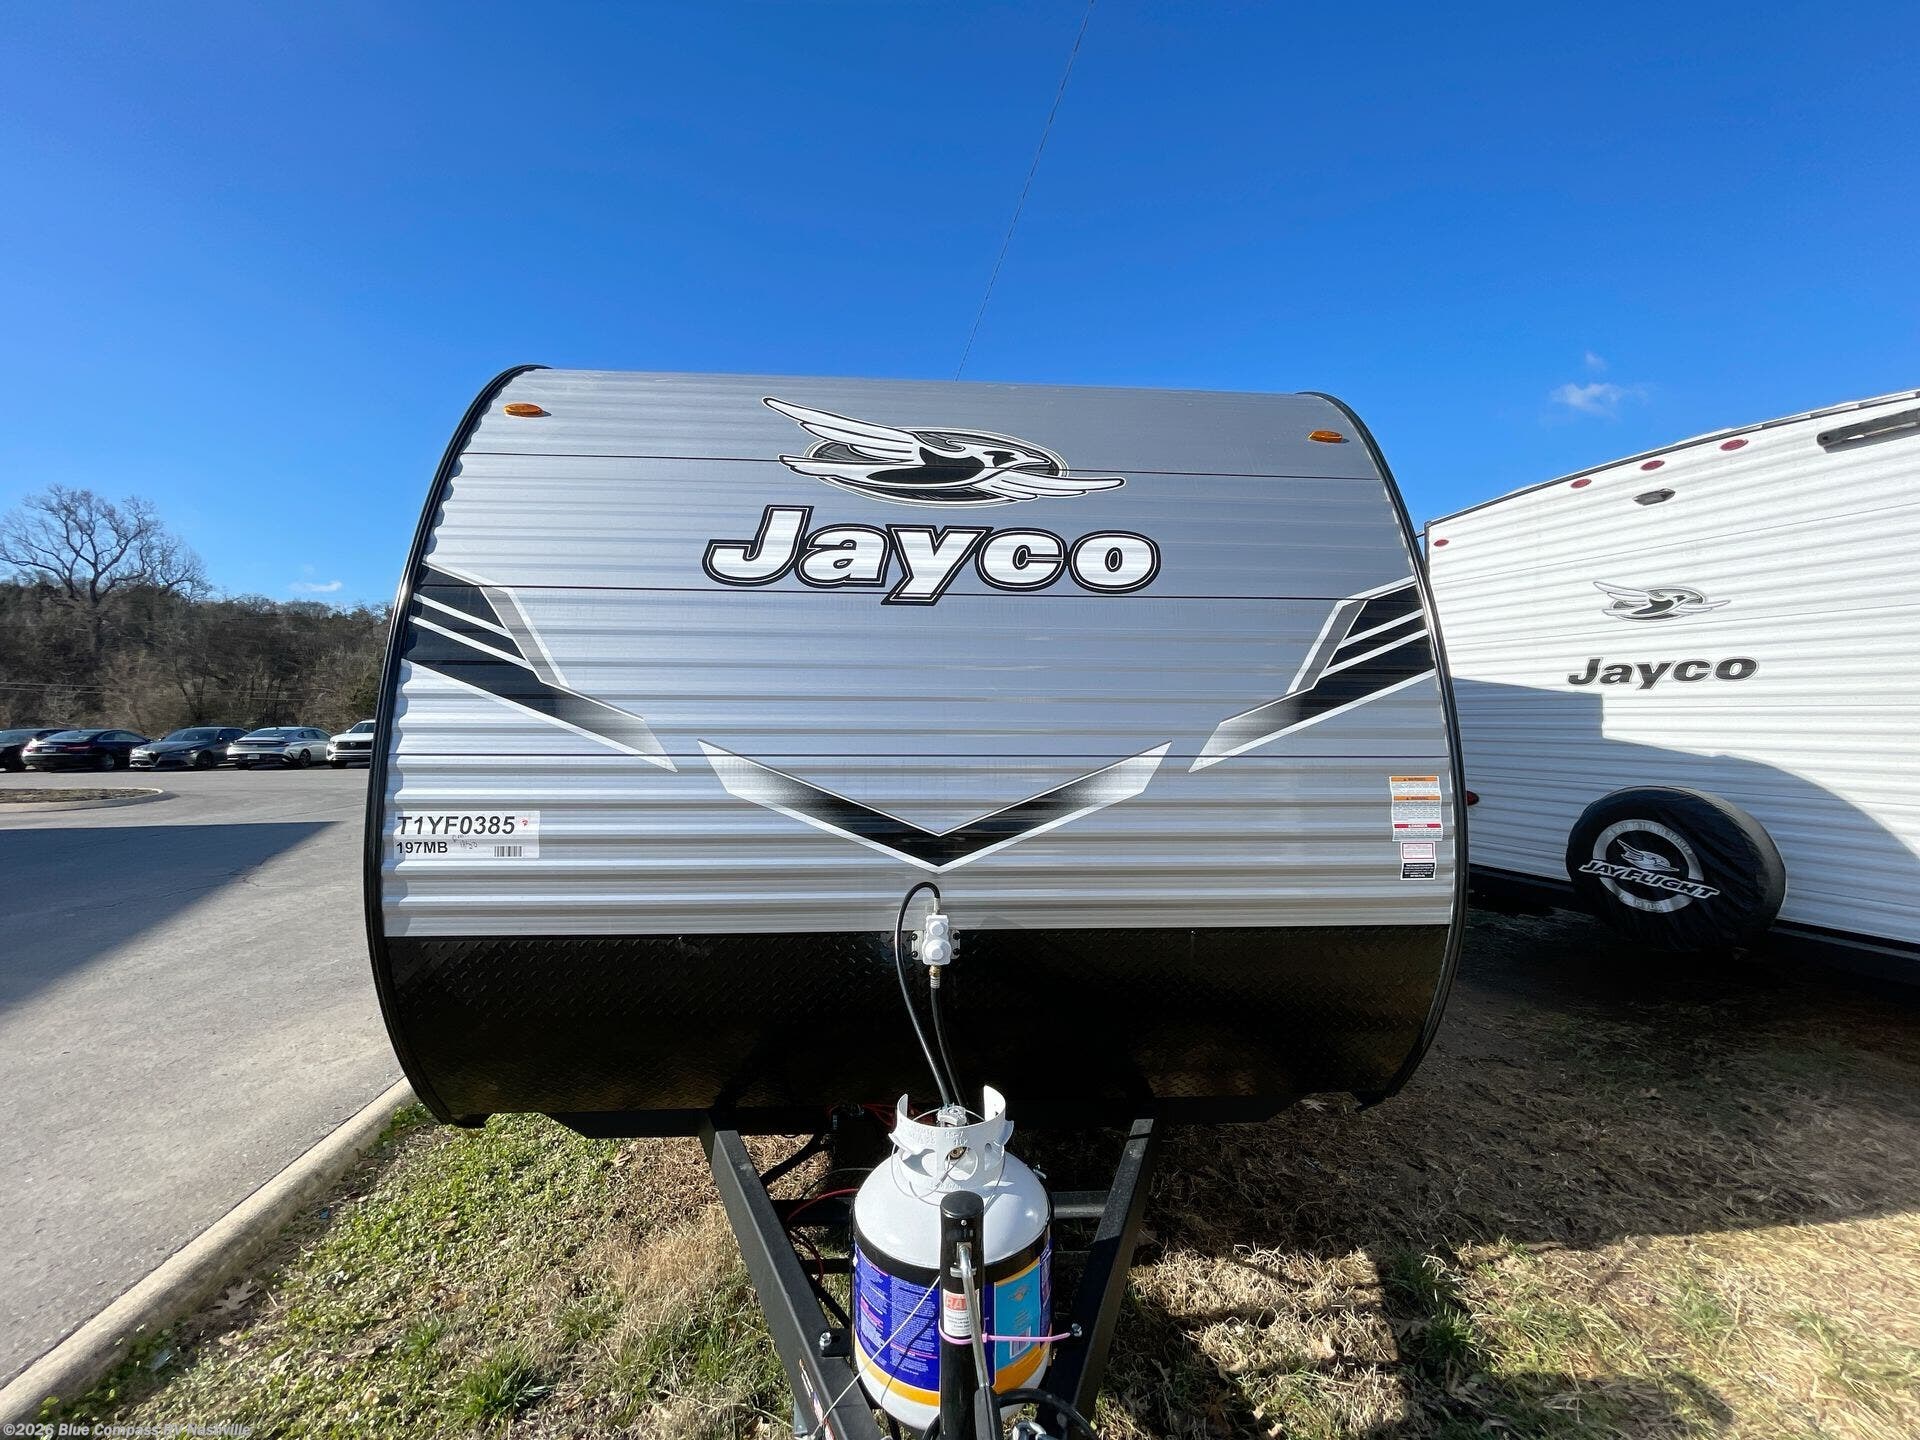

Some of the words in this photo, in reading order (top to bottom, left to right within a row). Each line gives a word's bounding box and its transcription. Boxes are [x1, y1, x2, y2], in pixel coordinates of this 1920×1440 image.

[701, 504, 1161, 606] Jayco
[1567, 656, 1760, 691] Jayco
[397, 815, 516, 835] T1YF0385
[396, 841, 448, 854] 197MB
